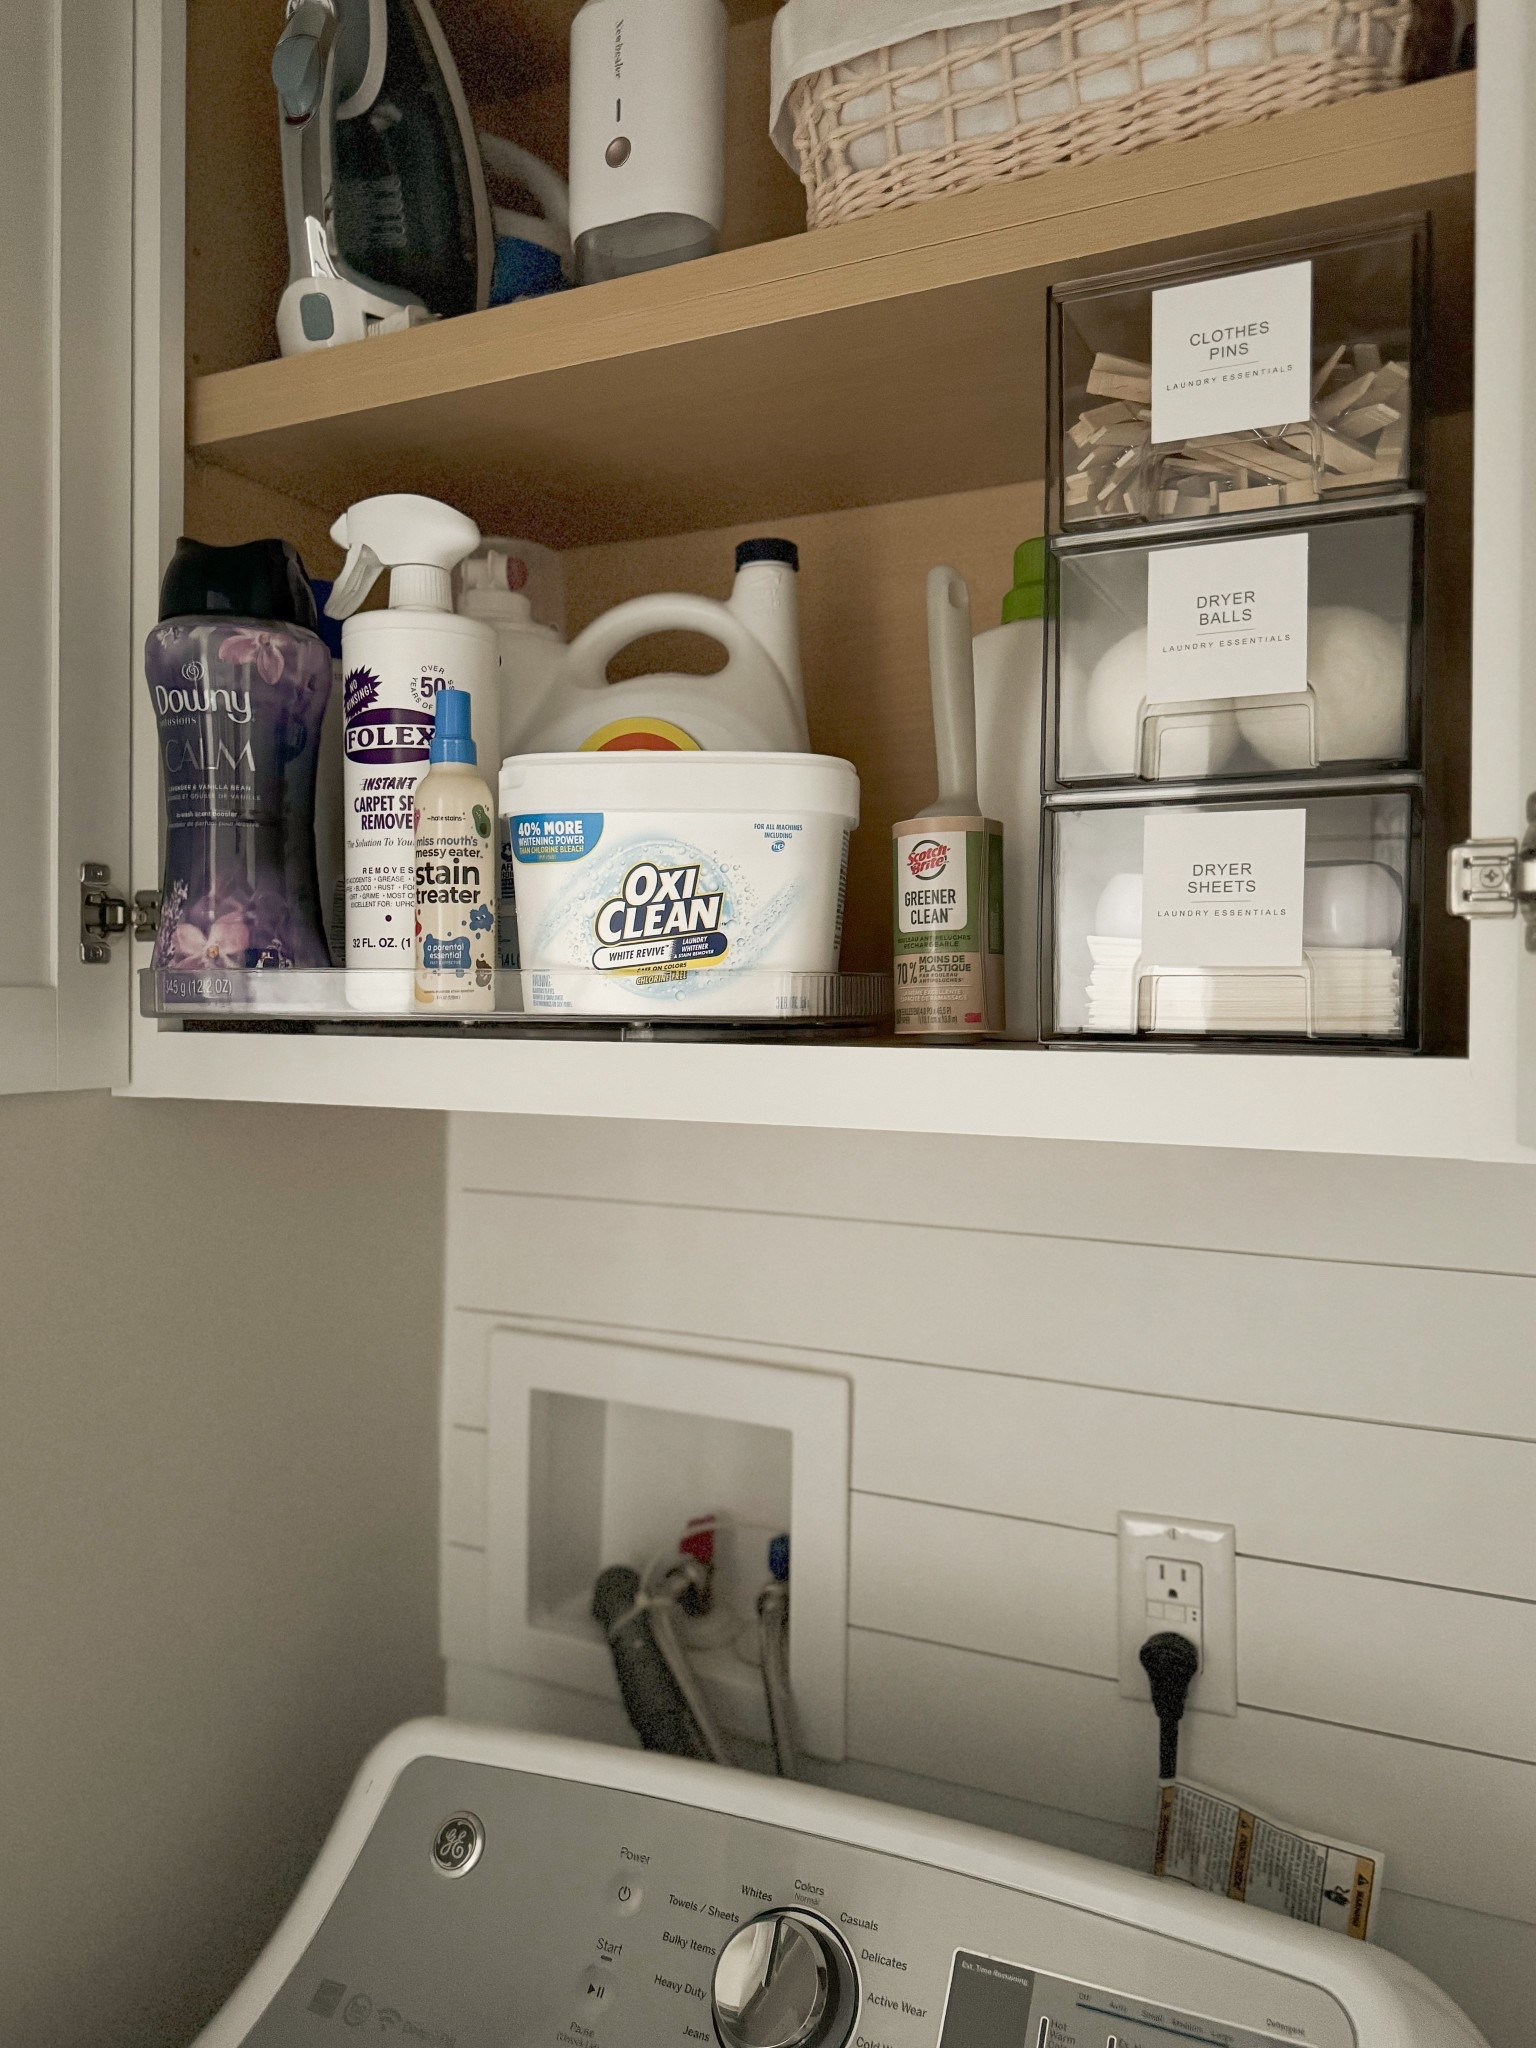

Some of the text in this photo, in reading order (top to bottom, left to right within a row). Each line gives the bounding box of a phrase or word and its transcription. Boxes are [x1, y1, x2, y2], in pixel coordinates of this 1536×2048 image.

[1189, 321, 1270, 346] CLOTHES
[1209, 342, 1249, 360] PINS
[1166, 364, 1293, 391] LAUNDRY ESSENTIALS
[1196, 590, 1256, 609] DRYER
[1199, 608, 1252, 626] BALLS
[1162, 634, 1291, 653] LAUNDRY ESSENTIALS
[421, 665, 445, 675] OVER
[349, 679, 358, 693] NO
[155, 685, 252, 724] Downy
[422, 702, 434, 710] OF
[348, 727, 435, 750] FOLEX
[165, 738, 256, 773] CALM
[361, 777, 417, 791] INSTANT
[354, 796, 395, 813] CARPET
[361, 813, 413, 831] REMOVE
[518, 820, 583, 836] 40% MORE
[355, 838, 382, 848] Solution
[384, 837, 394, 846] To
[397, 837, 414, 846] You
[417, 835, 478, 847] miss mouth's
[518, 835, 584, 846] WHITENING POWER
[560, 845, 583, 853] BLEACH
[415, 848, 480, 859] messy eater
[362, 866, 414, 874] REMOVES
[415, 857, 480, 886] stain
[1192, 863, 1252, 877] DRYER
[625, 865, 697, 906] OXI
[1187, 880, 1256, 894] SHEETS
[415, 886, 481, 904] treater
[904, 888, 956, 907] GREENER
[597, 896, 720, 943] CLEAN
[910, 908, 949, 925] CLEAN
[1214, 908, 1286, 917] ESSENTIALS
[353, 939, 361, 948] 32
[362, 938, 376, 948] FL.
[379, 938, 398, 948] OZ.
[433, 942, 464, 952] parental
[681, 943, 709, 952] WHITENER
[682, 936, 708, 945] LAUNDRY
[429, 951, 462, 959] essential
[609, 949, 634, 961] WHITE
[919, 956, 950, 964] MOINS
[664, 962, 687, 970] COLORS
[919, 964, 971, 972] PLASTIQUE
[215, 979, 232, 995] OZ)
[621, 1847, 650, 1864] Power
[741, 1885, 773, 1902] Whites
[794, 1880, 825, 1896] Colors
[669, 1894, 698, 1912] Towels
[708, 1905, 740, 1923] Sheets
[840, 1912, 879, 1931] Casuals
[597, 1938, 622, 1956] Start
[662, 1932, 717, 1956] Bulky Items
[861, 1949, 907, 1971] Delicates
[654, 1974, 707, 2000] Heavy Duty
[867, 1993, 927, 2018] Active Wear
[682, 2025, 710, 2042] Jeans
